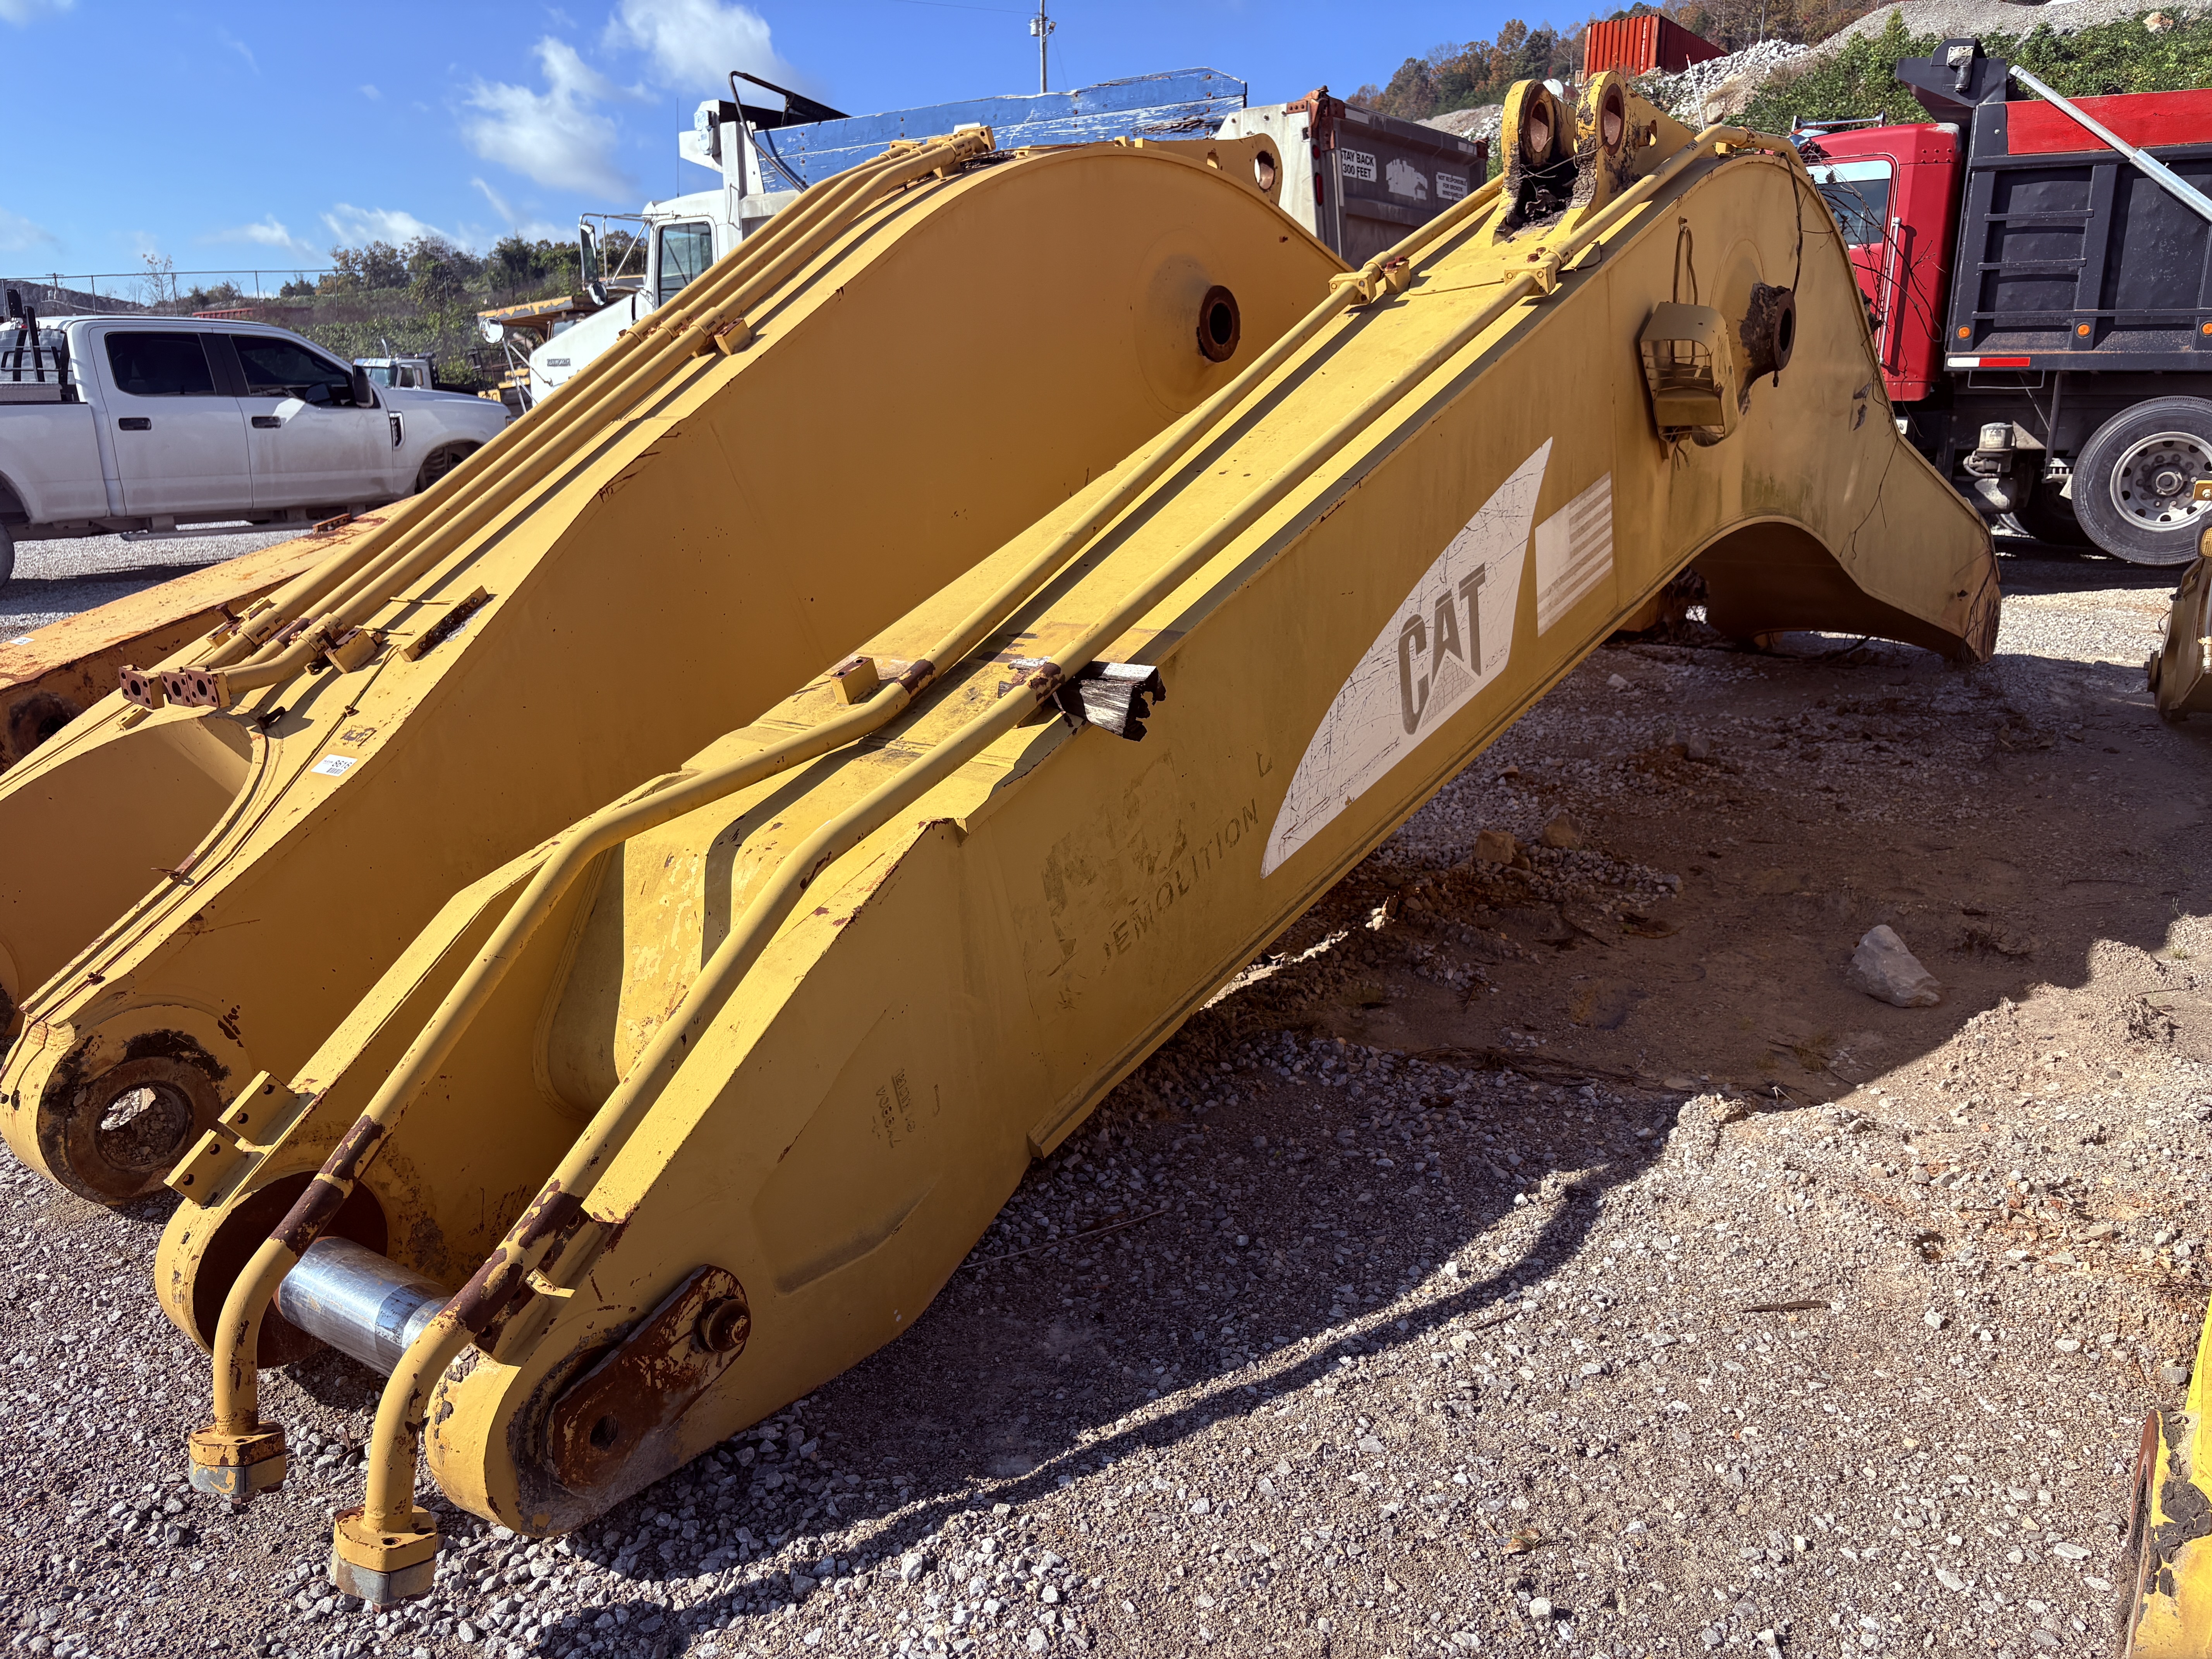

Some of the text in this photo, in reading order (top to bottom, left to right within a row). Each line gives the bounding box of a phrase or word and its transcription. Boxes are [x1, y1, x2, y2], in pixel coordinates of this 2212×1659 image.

[1357, 153, 1374, 167] BACK
[1342, 163, 1371, 179] 300 FEET
[1398, 562, 1486, 735] CAT
[332, 760, 352, 769] 8616
